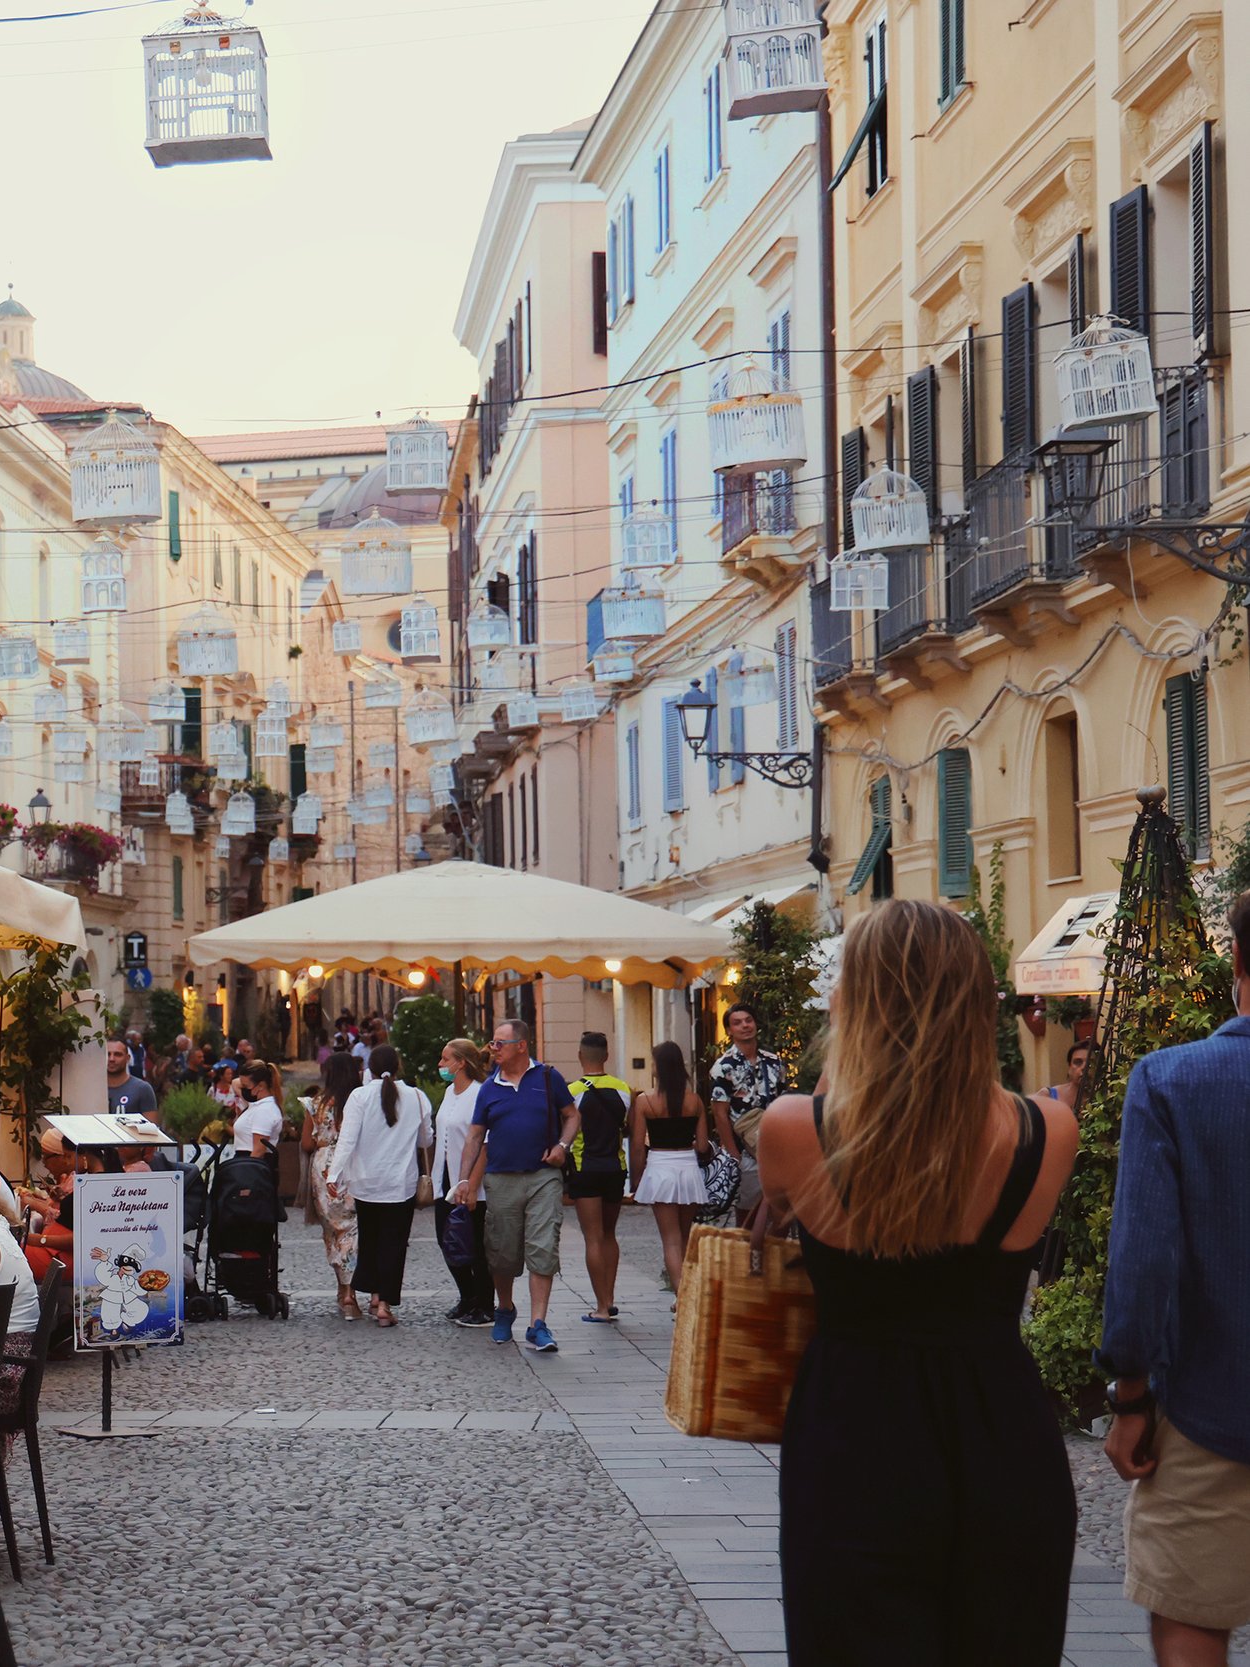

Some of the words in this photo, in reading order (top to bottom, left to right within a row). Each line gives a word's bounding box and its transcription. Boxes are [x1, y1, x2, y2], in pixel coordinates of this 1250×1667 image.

[111, 1185, 126, 1198] La
[128, 1187, 147, 1197] vera
[89, 1200, 117, 1214] Pizza
[118, 1200, 169, 1215] Napoletana
[139, 1224, 159, 1234] bufala
